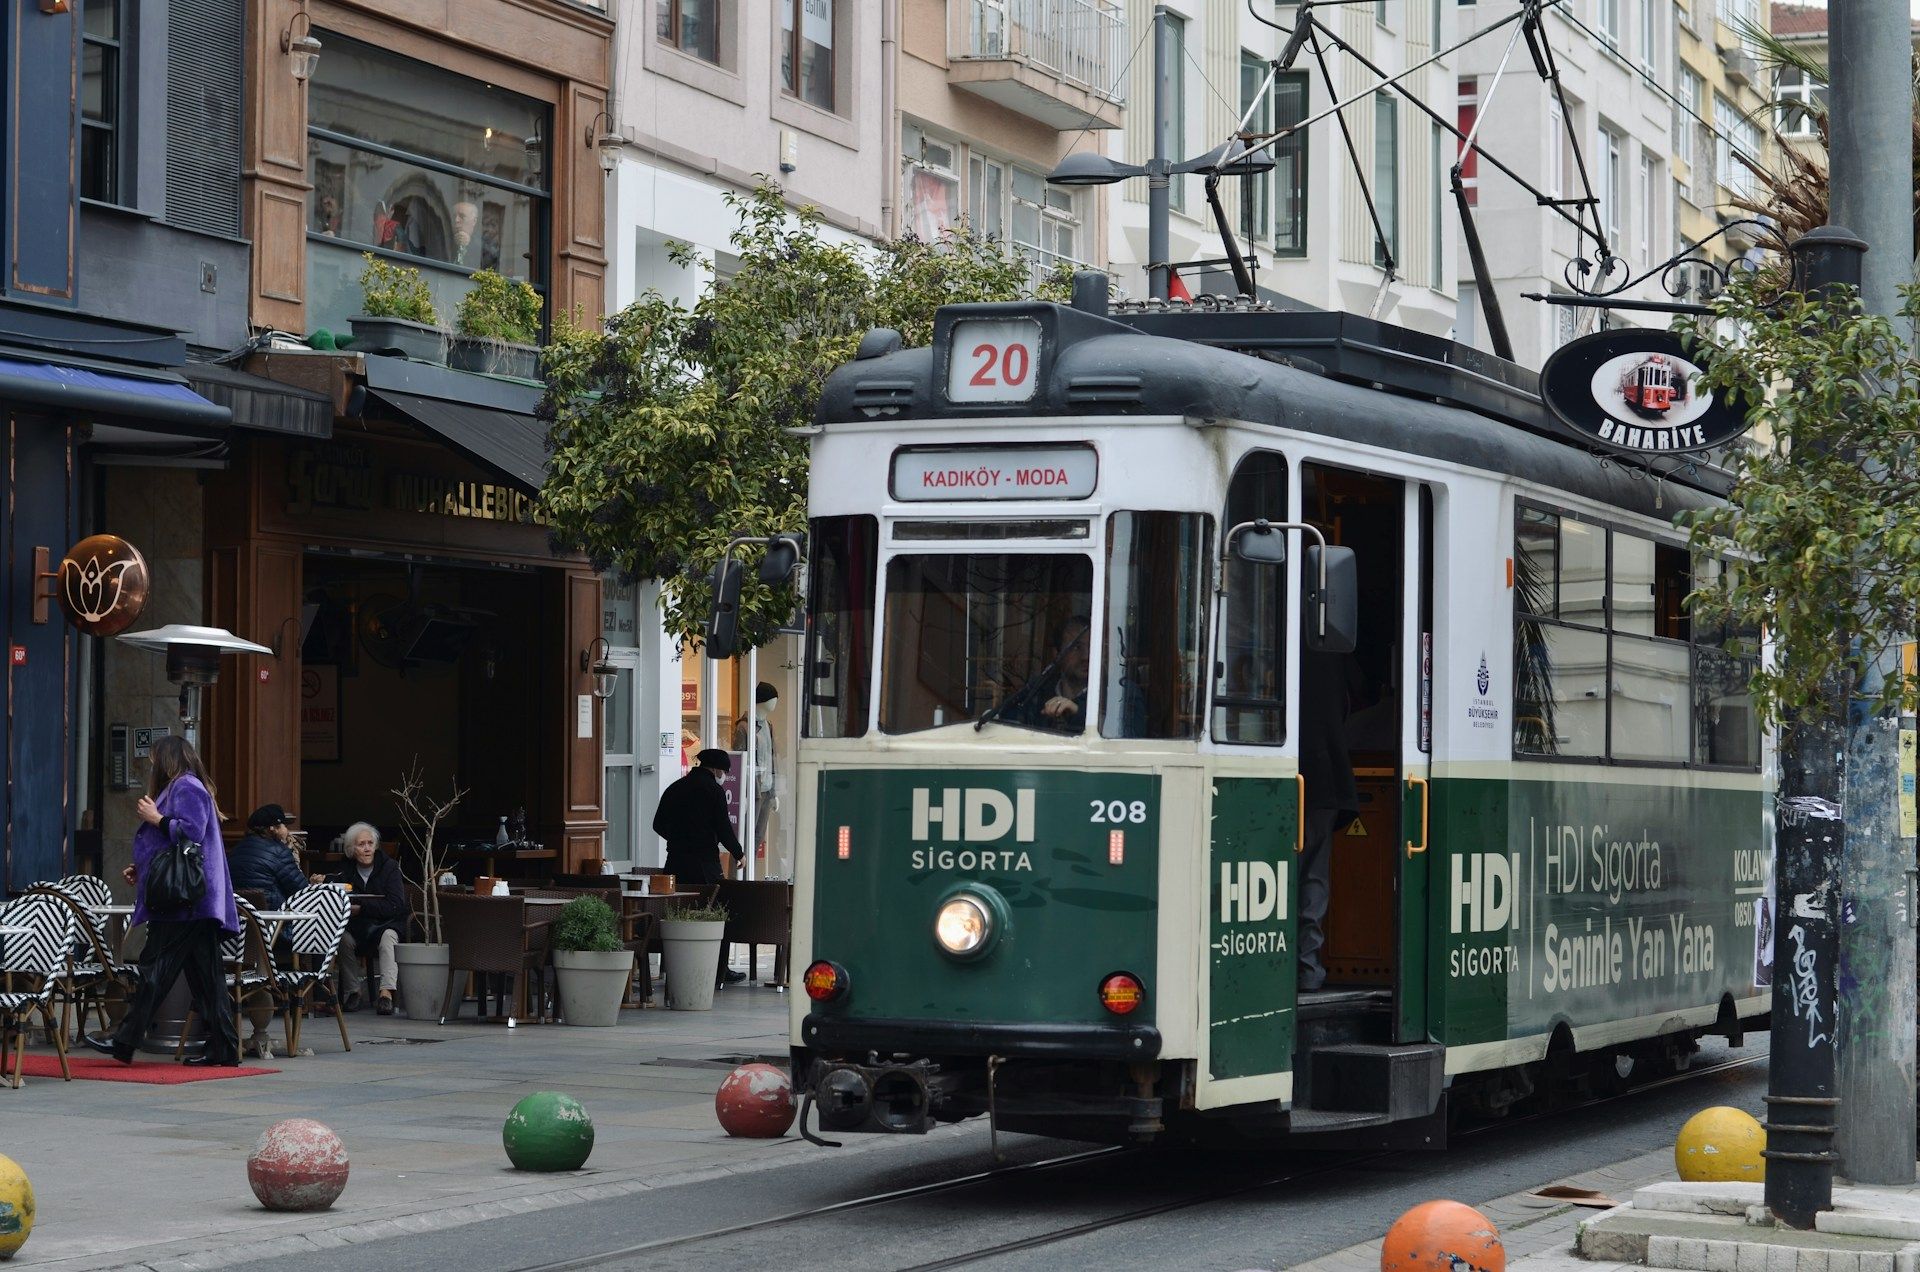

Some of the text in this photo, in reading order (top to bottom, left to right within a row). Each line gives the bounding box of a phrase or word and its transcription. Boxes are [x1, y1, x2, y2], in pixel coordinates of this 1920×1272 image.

[969, 343, 1029, 387] 20
[1597, 417, 1707, 450] BAHARİYE
[923, 466, 1001, 487] KADIKÖY
[1016, 468, 1068, 486] MODA
[911, 787, 1036, 842] HDI
[1090, 799, 1147, 824] 208
[911, 846, 1033, 872] SİGORTA
[1546, 824, 1661, 905] HDI Sigorta
[1220, 860, 1289, 924] HDI
[1450, 852, 1521, 934] HDI
[1734, 901, 1752, 927] 0850
[1220, 929, 1287, 956] SİGORTA
[1449, 942, 1519, 978] SİGORTA
[1543, 917, 1623, 994] Seninle
[1628, 916, 1665, 981] Yan
[1669, 913, 1714, 975] Yana
